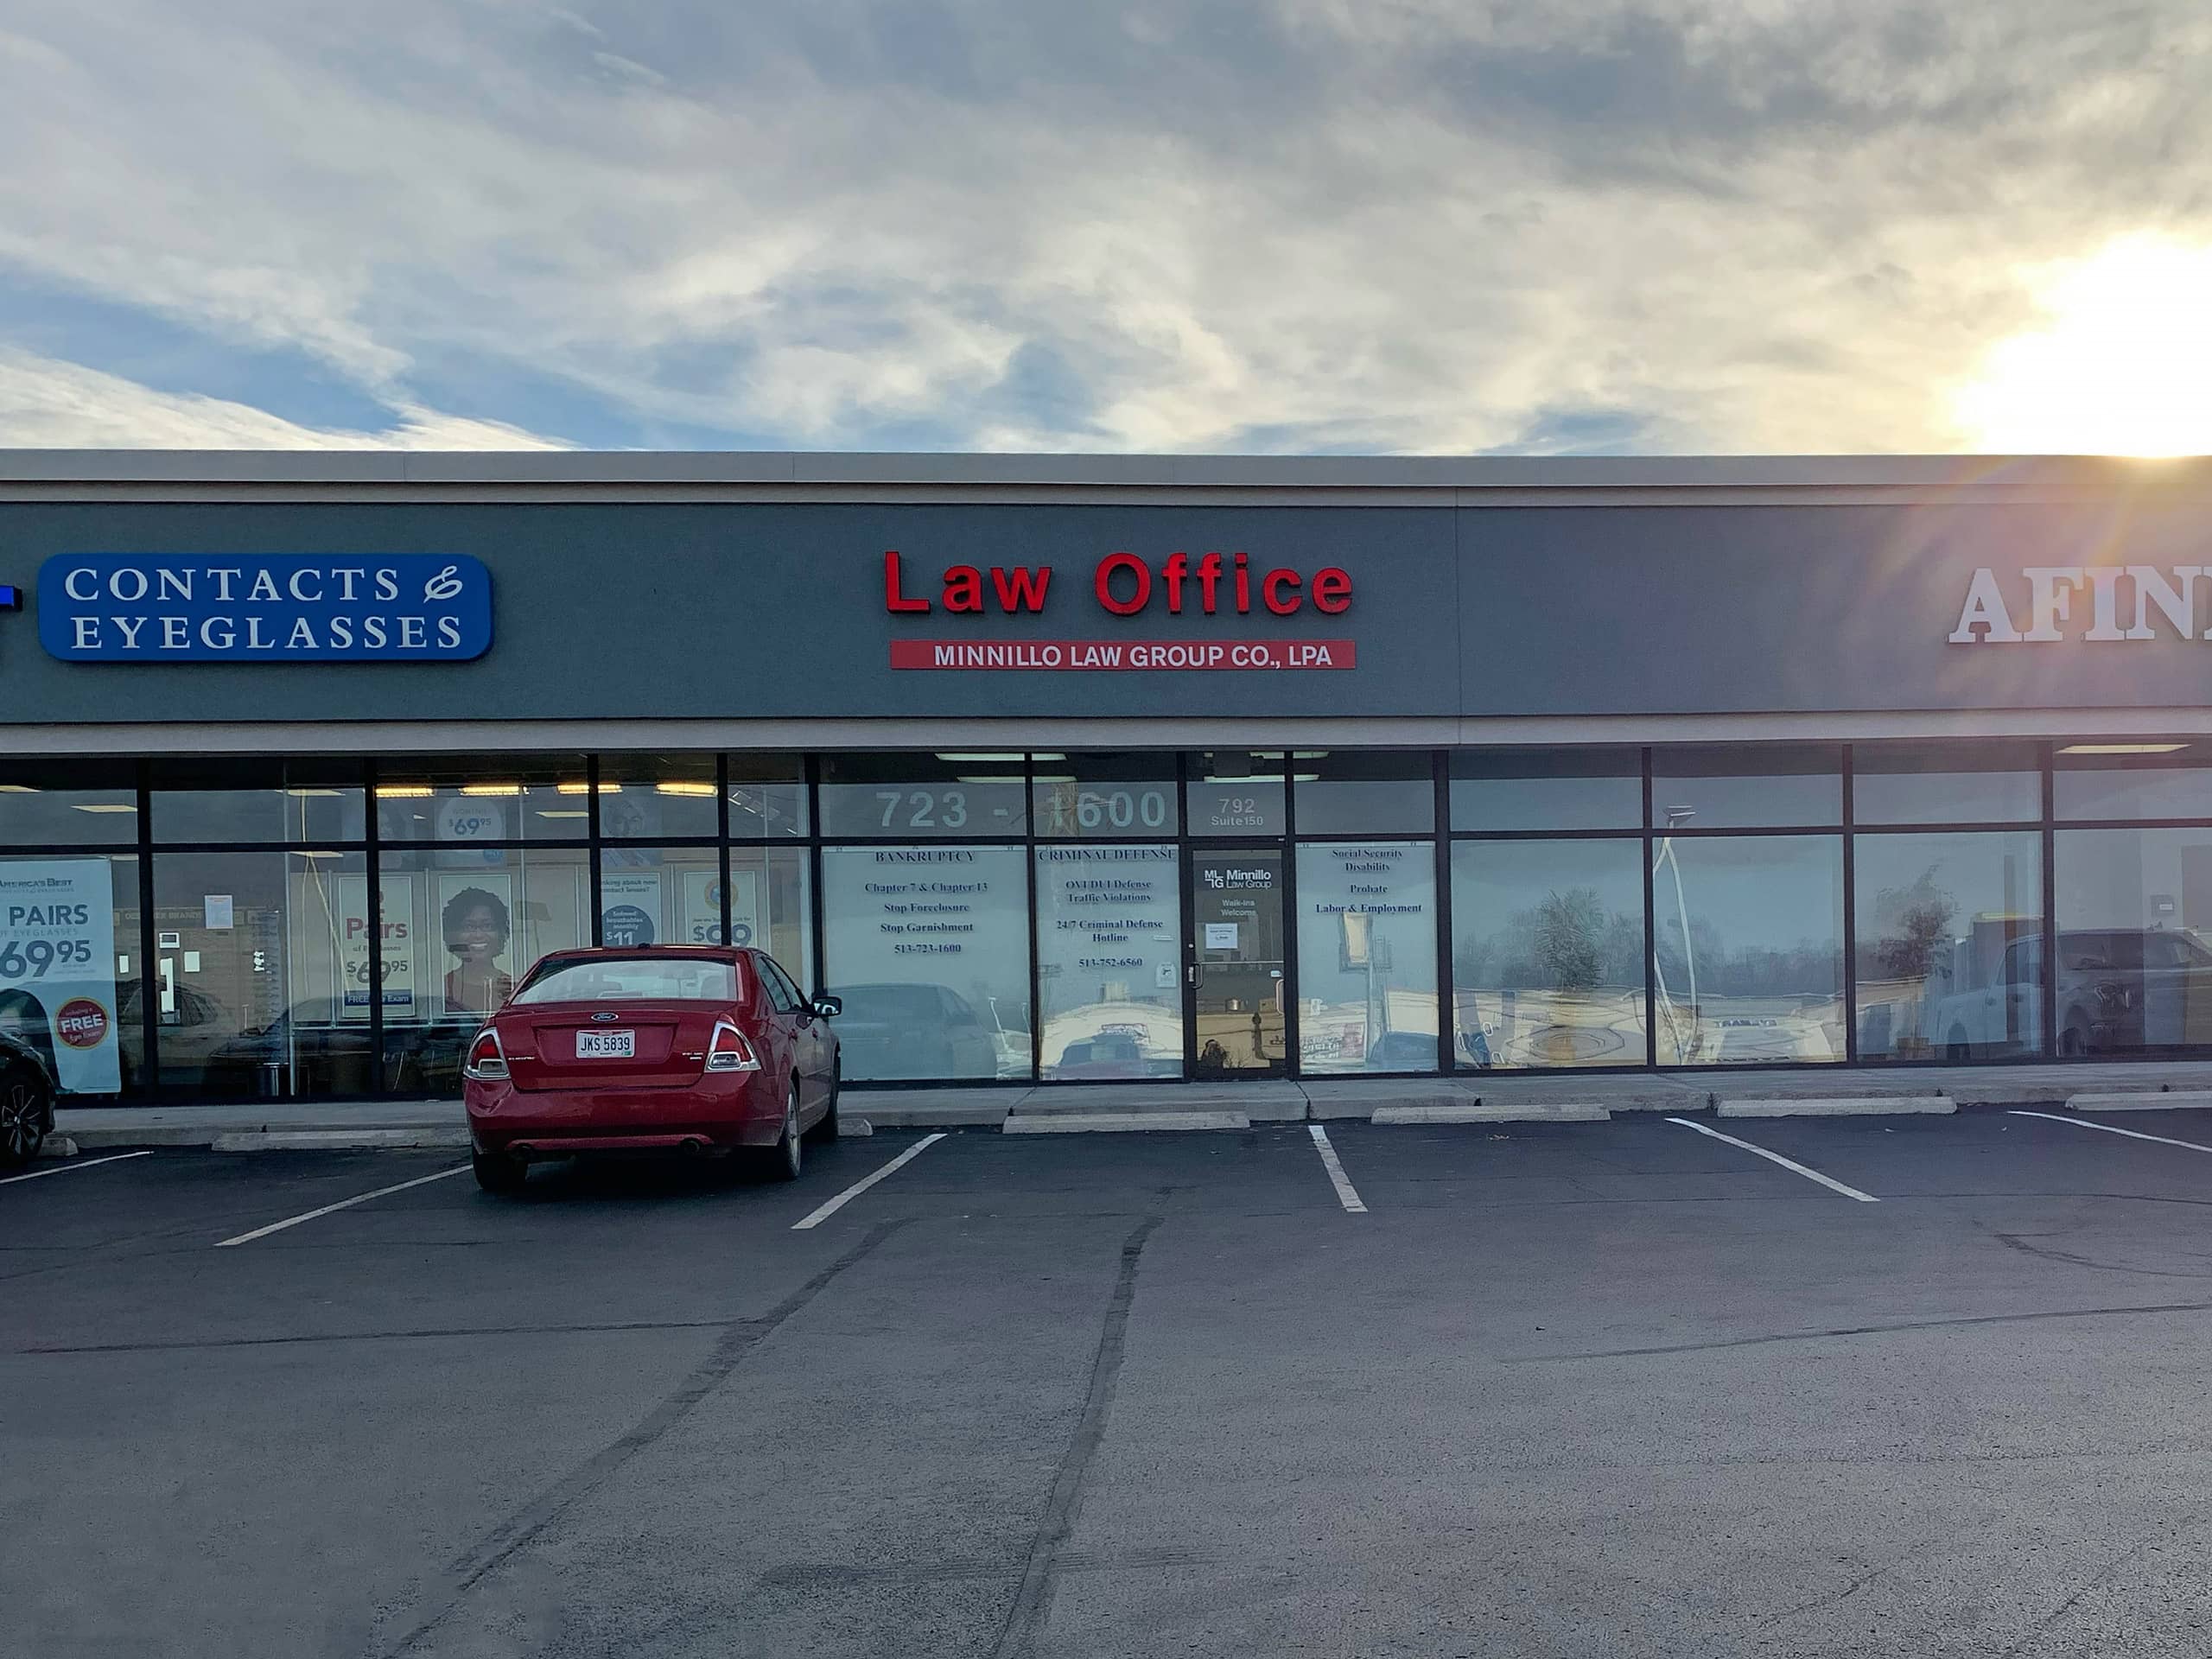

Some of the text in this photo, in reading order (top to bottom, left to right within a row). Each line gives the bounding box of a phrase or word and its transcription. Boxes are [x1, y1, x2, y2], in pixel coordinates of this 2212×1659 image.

[65, 568, 398, 601] CONTACTS
[885, 551, 1353, 616] Law Office
[1947, 566, 2212, 644] AFIN
[71, 616, 461, 650] EYEGLASSES
[934, 645, 1332, 670] MINNILLO LAW GROUP CO., LPA
[875, 791, 968, 828] 723
[1050, 791, 1166, 828] 1600
[1218, 798, 1255, 813] 792
[1211, 816, 1264, 826] Suite 150
[875, 851, 975, 862] BANKRUPTCY
[1039, 849, 1175, 861] CRIMINAL DEFENSE
[1332, 849, 1403, 861] Social Security
[1345, 862, 1390, 872] Disability
[1226, 869, 1272, 880] Minnillo
[865, 881, 988, 894] Chapter 7 & Chapter 13
[1114, 879, 1152, 888] Defense
[1226, 880, 1273, 890] Law Group
[1350, 884, 1389, 893] Probate
[1067, 893, 1151, 902] Traffic Violations
[884, 903, 970, 914] Stop Foreclosure
[1316, 904, 1422, 915] Labor & Employment
[9, 904, 89, 926] PAIRS
[880, 922, 974, 934] Stop Garnishment
[1057, 918, 1164, 930] 24/7 Criminal Defense
[1092, 932, 1128, 943] Hotline
[893, 944, 962, 954] 513-723-1600
[1078, 957, 1143, 968] 513-752-6560
[60, 1013, 104, 1033] FREE
[580, 1037, 631, 1052] JKS 5839
